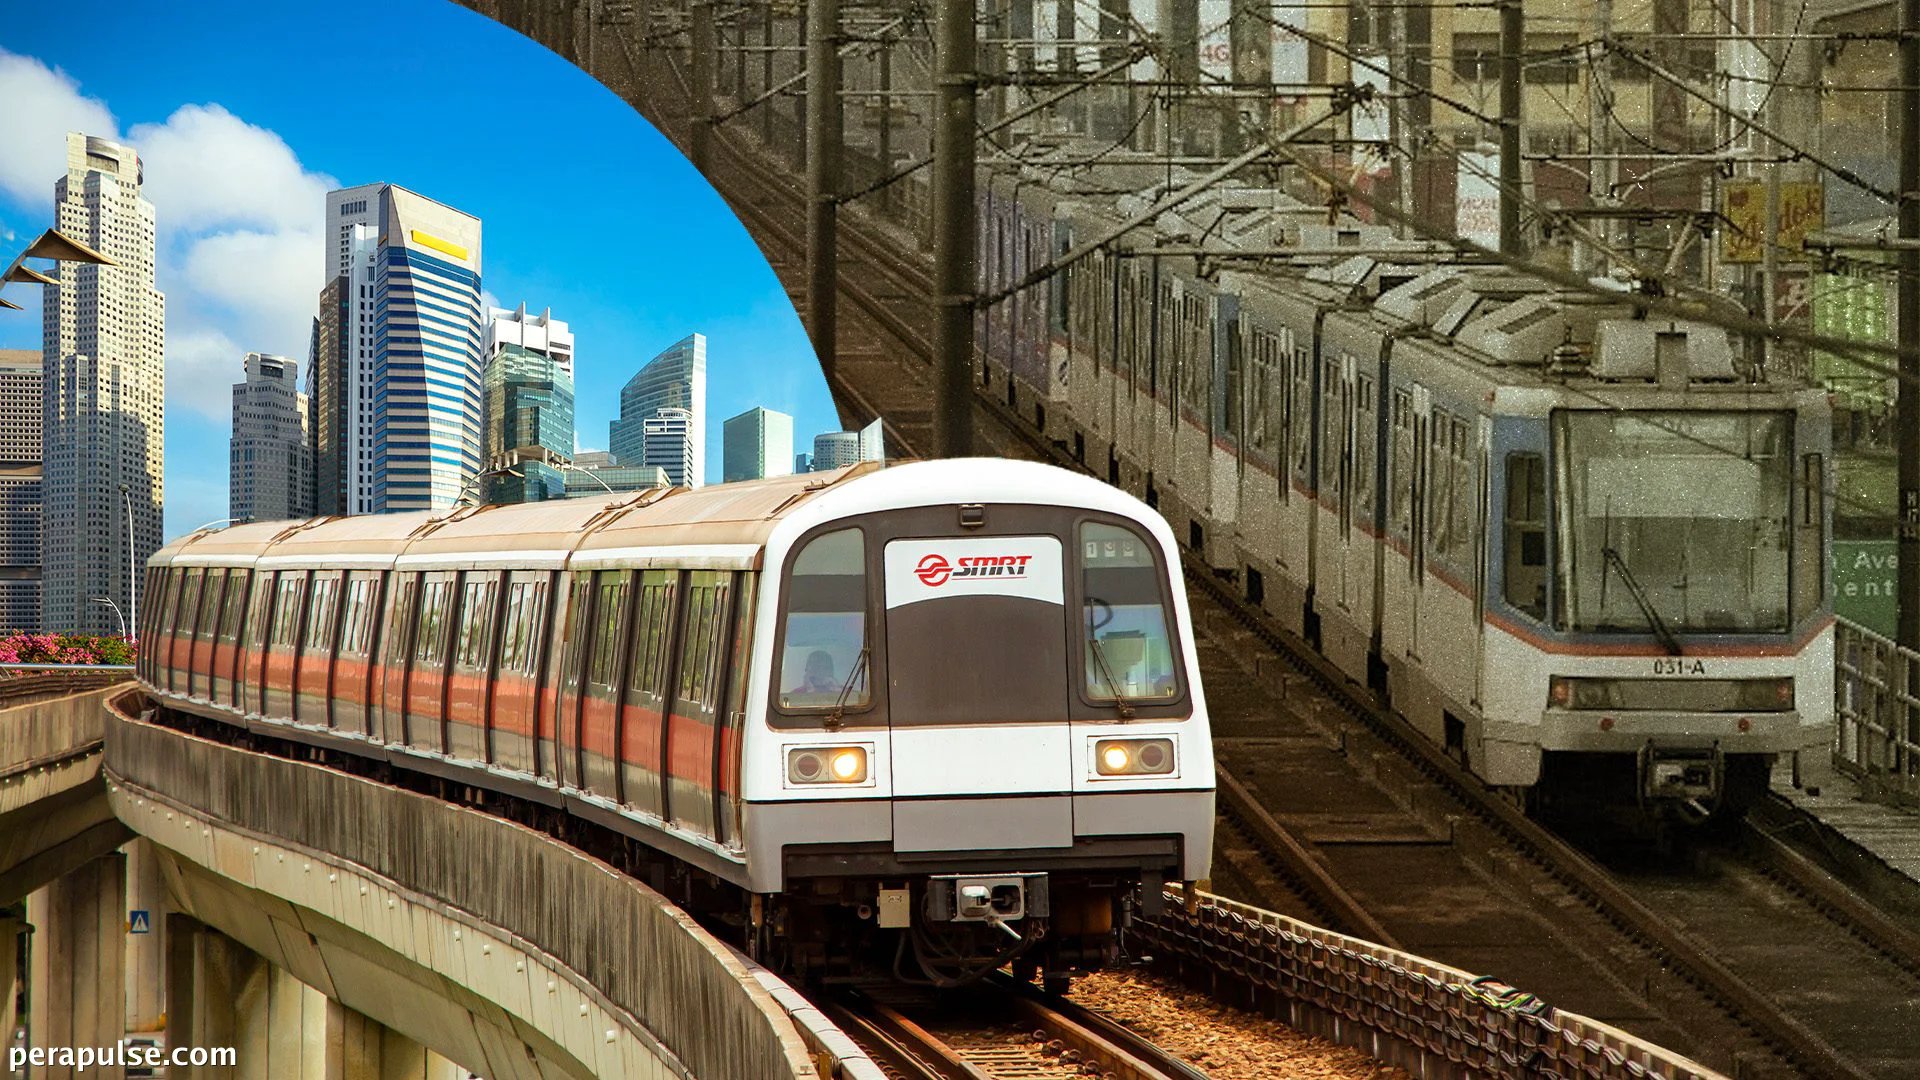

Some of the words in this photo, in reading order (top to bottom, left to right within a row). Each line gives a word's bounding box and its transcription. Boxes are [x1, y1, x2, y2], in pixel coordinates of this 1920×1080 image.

[952, 555, 1032, 576] SMRT
[1854, 551, 1898, 569] Ave
[1654, 659, 1705, 674] 031-A
